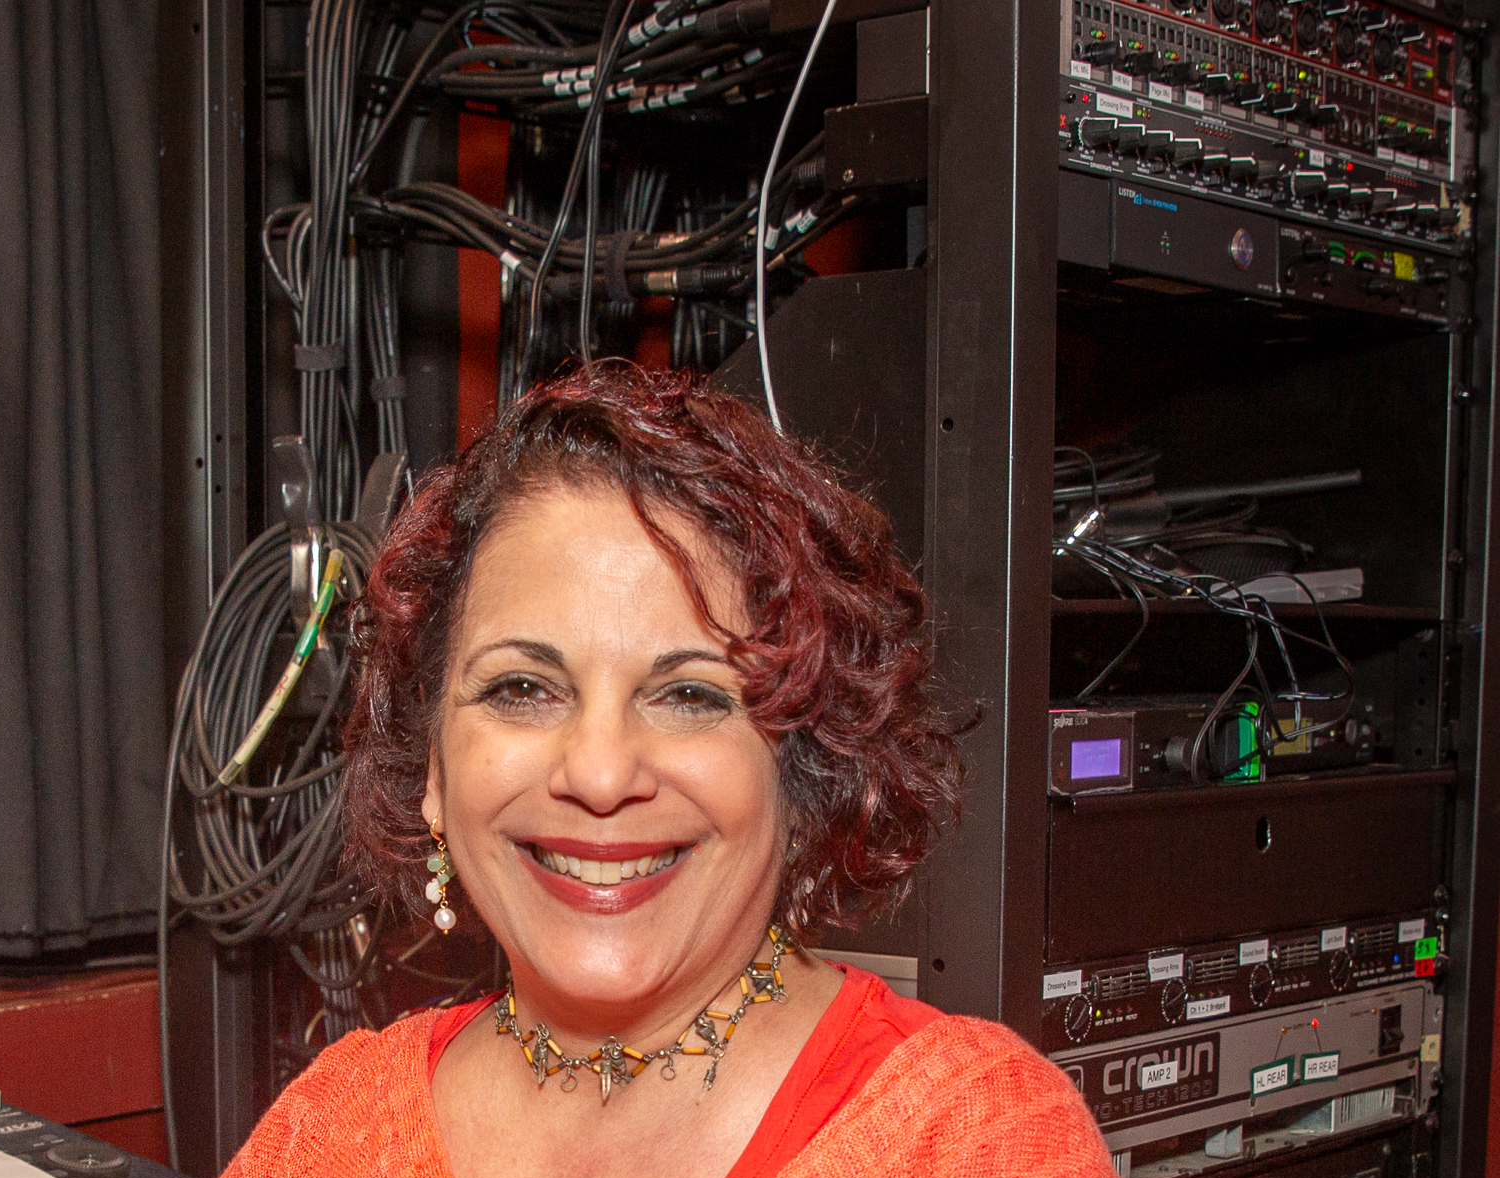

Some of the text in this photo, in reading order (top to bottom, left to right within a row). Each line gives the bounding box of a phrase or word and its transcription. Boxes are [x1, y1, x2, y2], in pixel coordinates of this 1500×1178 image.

[1151, 963, 1179, 974] Dressing Rms
[1047, 980, 1078, 991] Dressing Rms
[1147, 1067, 1171, 1083] AMP 2
[1307, 1059, 1336, 1075] HR REAR
[1256, 1069, 1286, 1088] HL REAR
